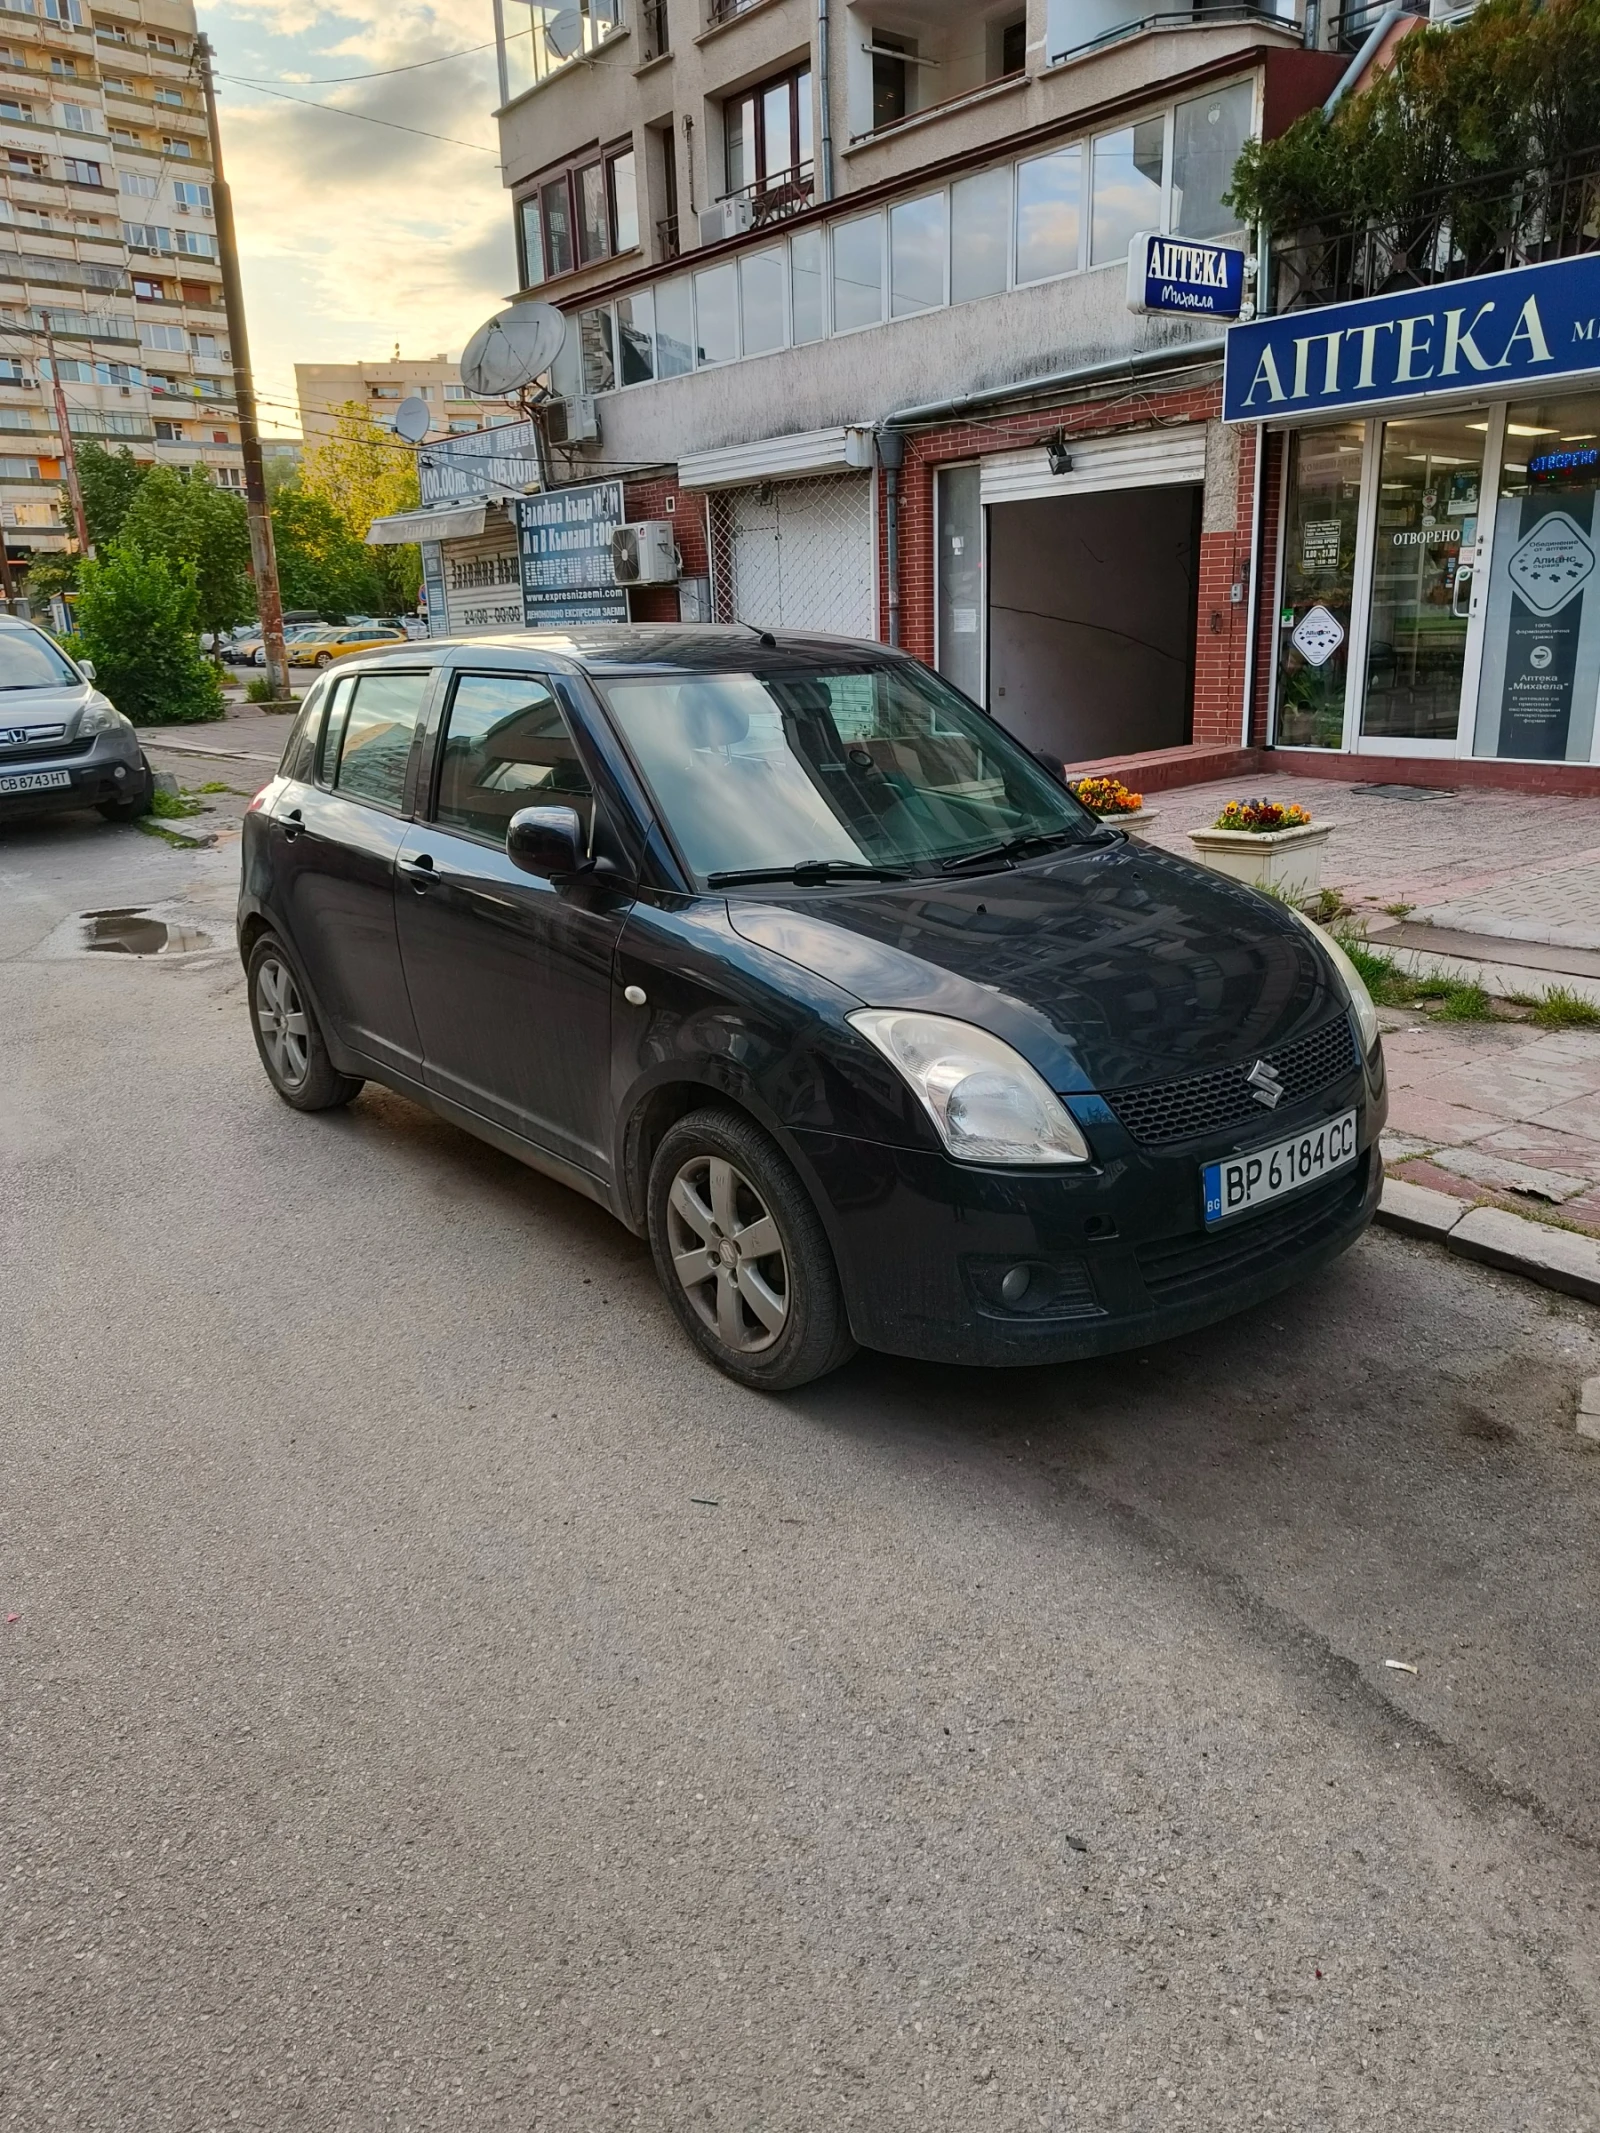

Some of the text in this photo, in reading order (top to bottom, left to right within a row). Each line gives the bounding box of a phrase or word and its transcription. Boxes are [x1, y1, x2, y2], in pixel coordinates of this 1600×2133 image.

[1148, 241, 1228, 288] АПТЕКА
[1161, 284, 1214, 309] Михаела
[1240, 294, 1600, 407] АПТЕКА М
[1531, 449, 1597, 471] ОТВОРЕНО
[593, 520, 617, 547] ЕОО
[1393, 529, 1460, 546] ОТВОРЕНО
[1529, 540, 1579, 548] Обединение
[1533, 556, 1577, 565] Алианс
[526, 589, 623, 602] www.expresnizaemi.com
[1519, 674, 1558, 682] Аптека
[19, 774, 50, 789] 8743
[51, 773, 66, 785] HT
[1226, 1117, 1353, 1208] BP 6184 CC
[1207, 1198, 1220, 1213] BG
